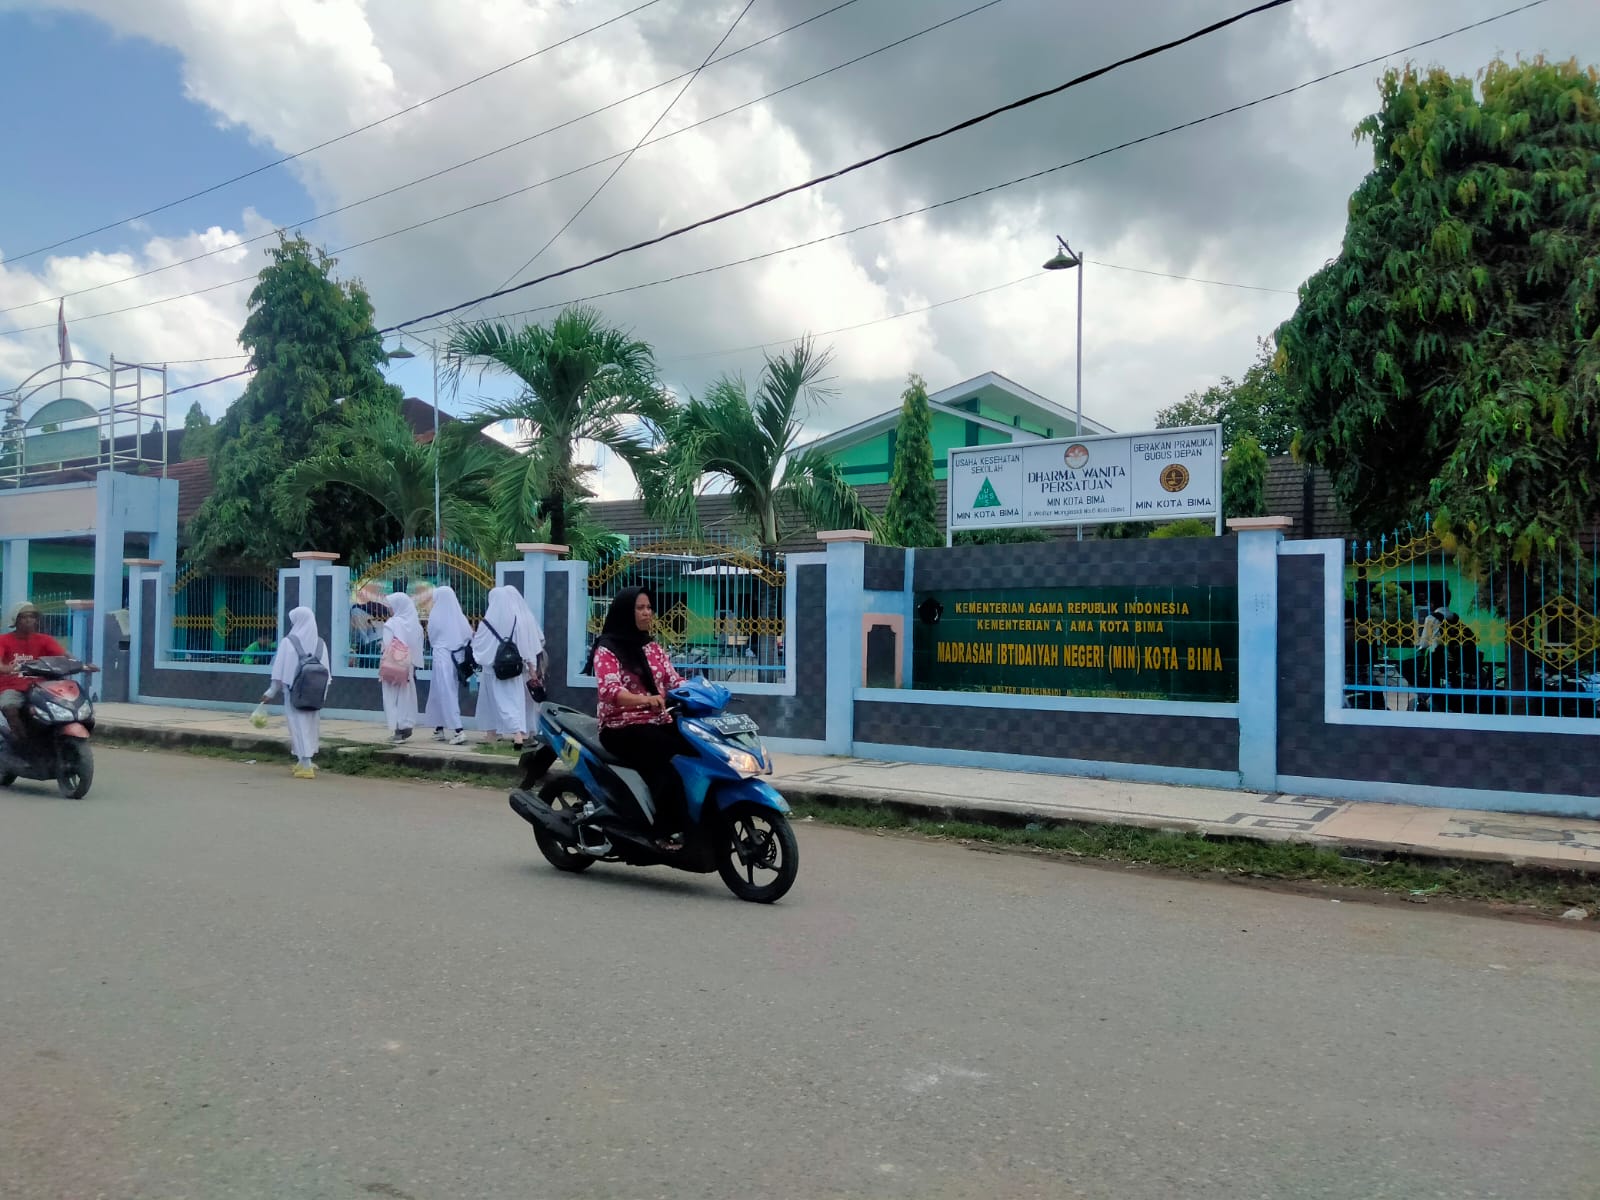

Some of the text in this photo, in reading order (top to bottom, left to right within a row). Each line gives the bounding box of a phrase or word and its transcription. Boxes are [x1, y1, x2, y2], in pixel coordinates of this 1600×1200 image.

[1133, 438, 1213, 453] GERAKAN PRAMUKA
[955, 454, 1020, 468] USAHA KESEHATAN
[1144, 448, 1202, 461] GUGUS DEPAN
[971, 464, 1003, 474] SEKOLAH
[1028, 465, 1125, 484] DHARMA WANITA
[1041, 478, 1113, 493] PERSATUAN
[1047, 495, 1105, 506] MIN KOTA BIMA
[1135, 497, 1212, 509] MIN KOTA BIMA
[956, 508, 1019, 520] MIN KOTA BIMA
[955, 600, 1189, 615] KEMENTERIAN AGAMA REPUBLIK INDONESIA
[976, 619, 1049, 631] KEMENTERIAN
[1099, 620, 1129, 633] KOTA
[1135, 621, 1164, 633] BIMA
[936, 642, 1223, 674] MADRASAH IBTIDAIYAH NEGERI (MIN) KOTA BIMA
